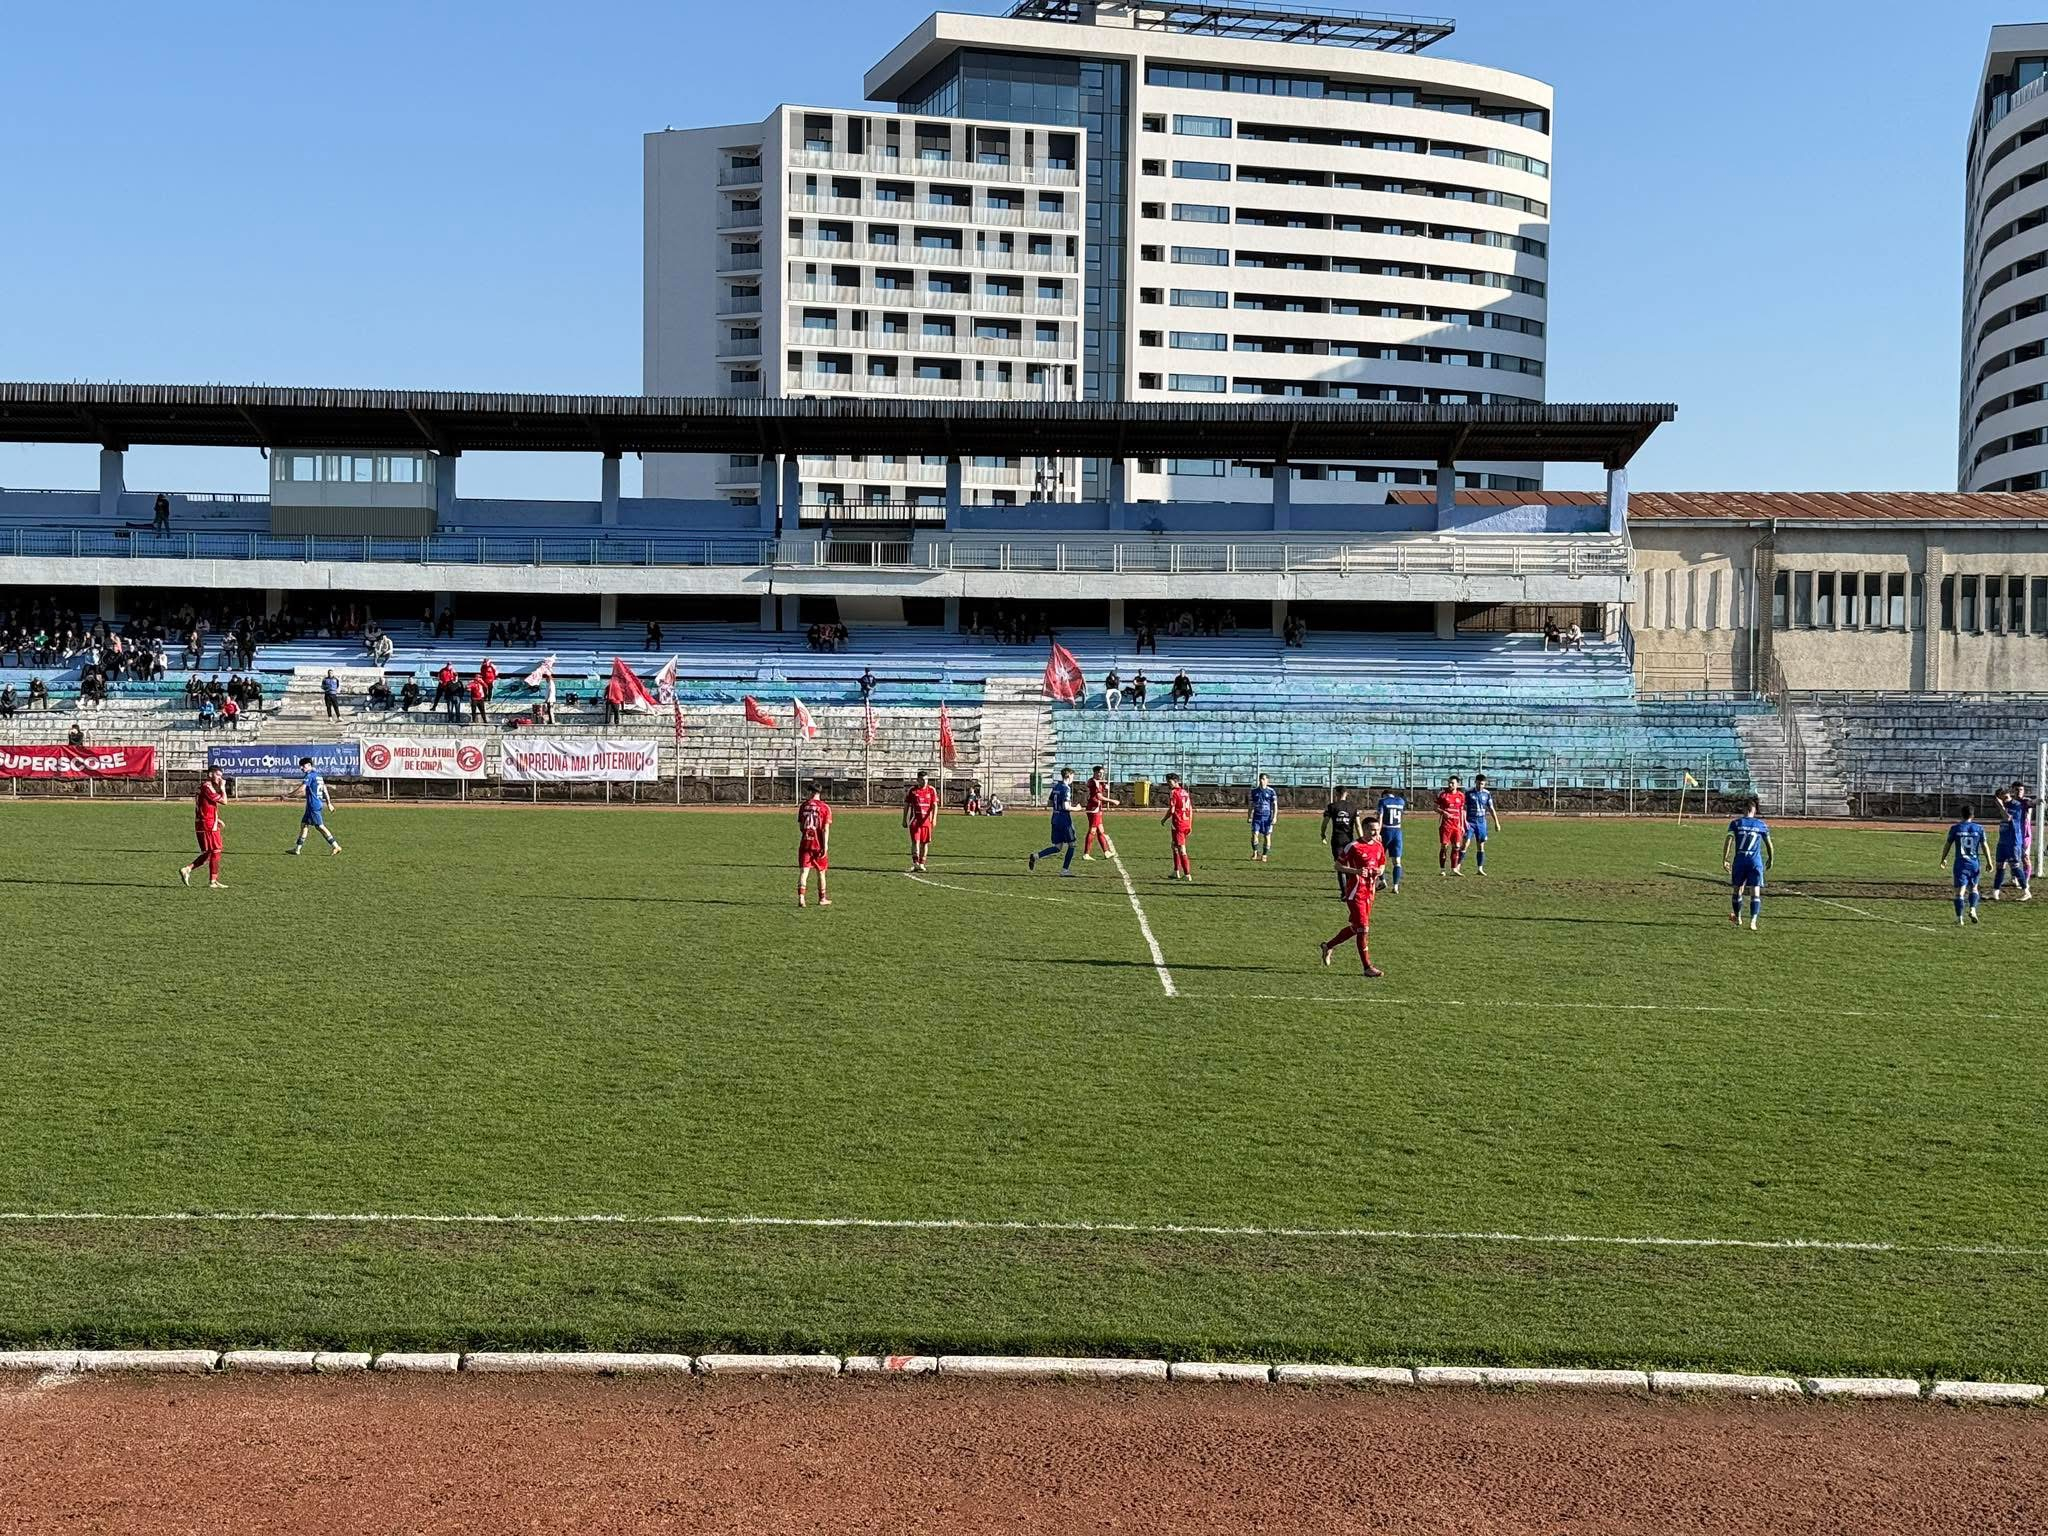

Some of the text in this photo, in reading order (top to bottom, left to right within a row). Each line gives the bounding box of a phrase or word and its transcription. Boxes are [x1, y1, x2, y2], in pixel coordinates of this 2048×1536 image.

[393, 747, 420, 757] MEREU
[213, 757, 235, 767] ADU
[404, 760, 414, 770] DE
[516, 749, 645, 773] ÎMPREUNĂ MAI PUTERNICI
[1389, 808, 1402, 825] 14
